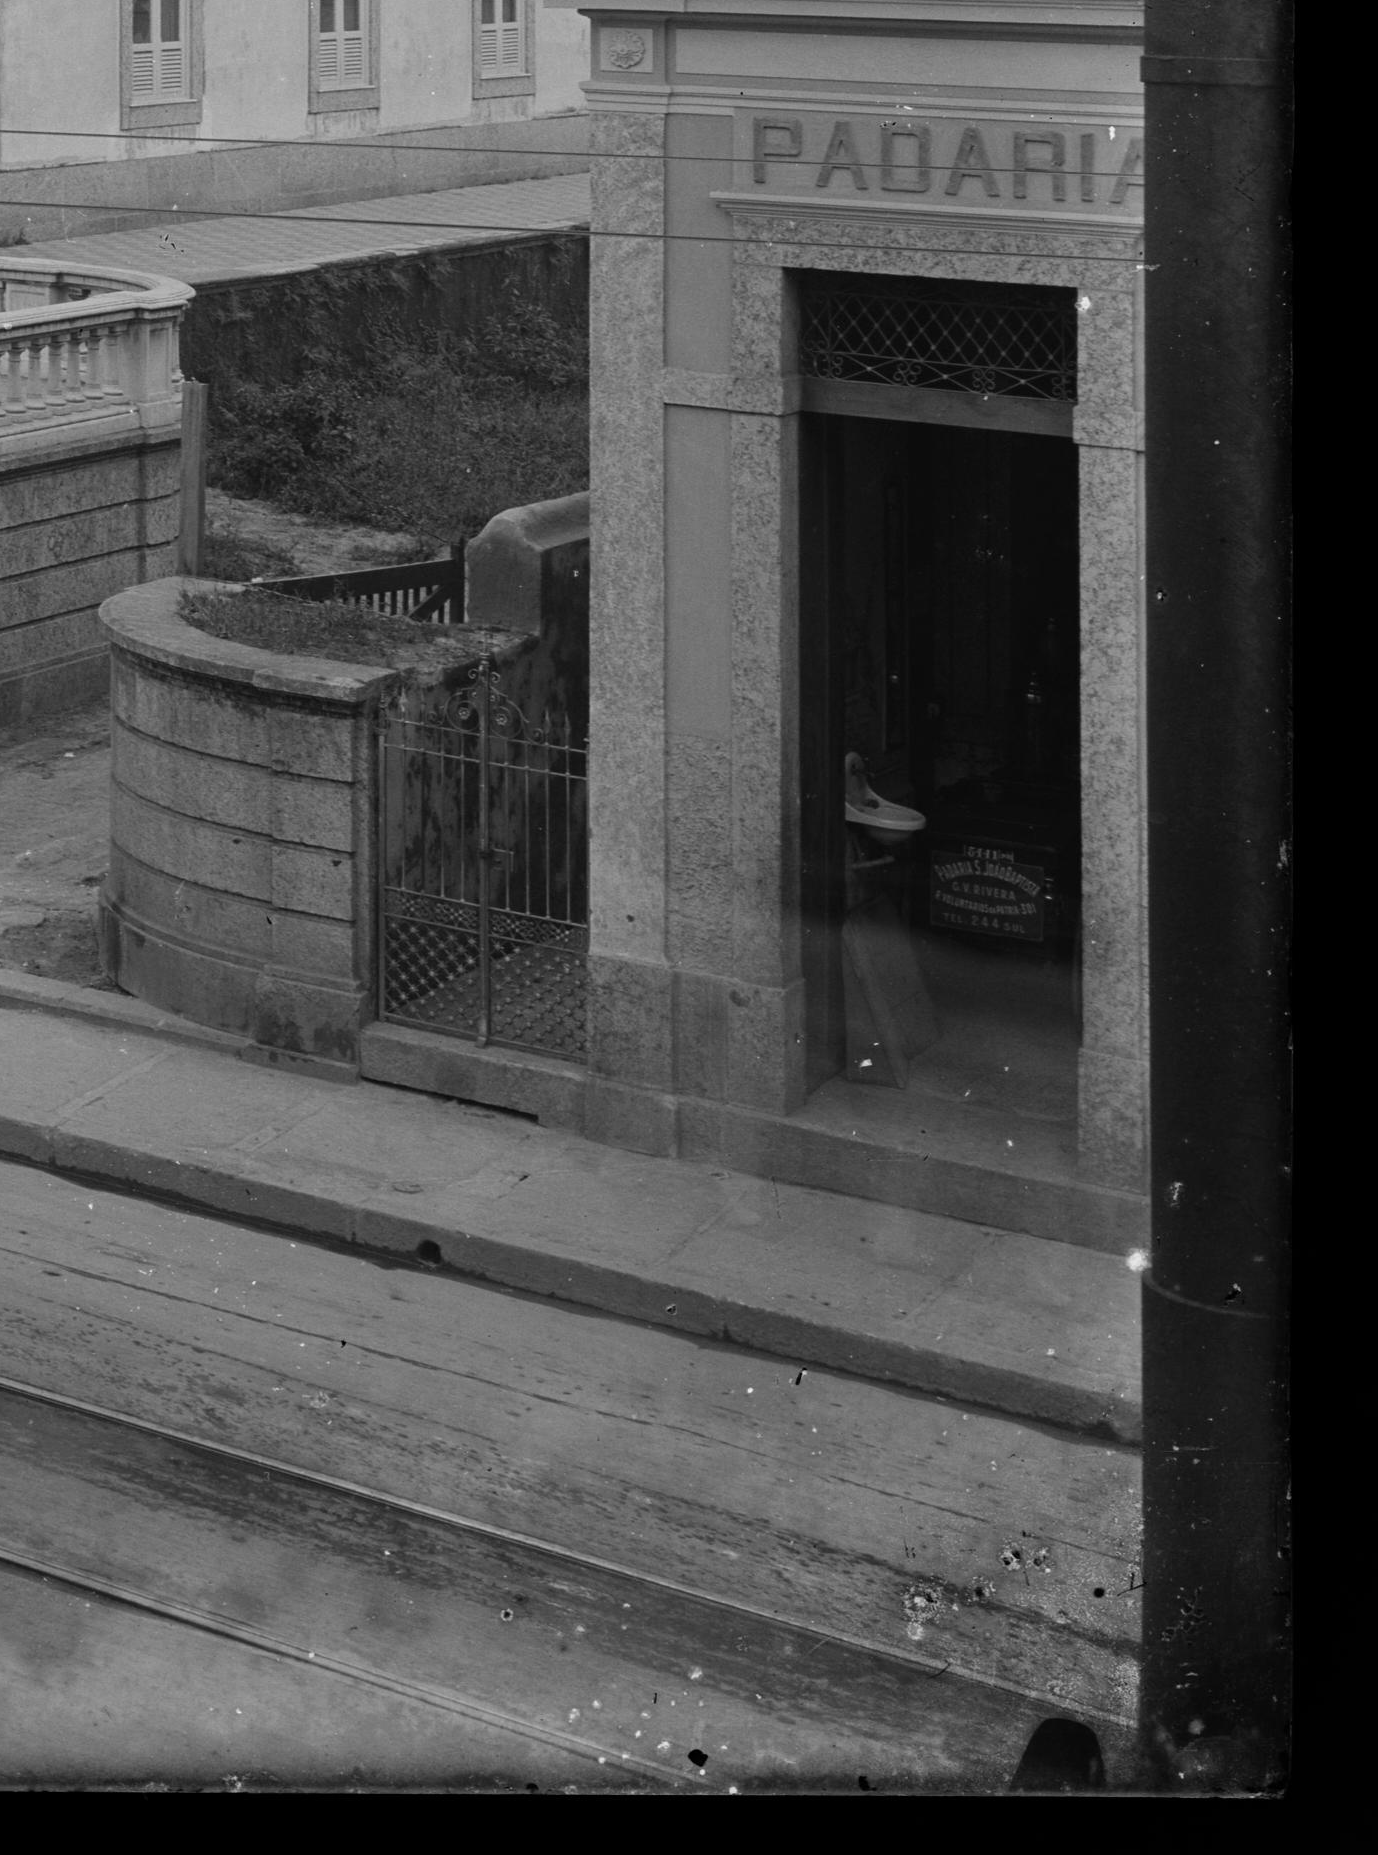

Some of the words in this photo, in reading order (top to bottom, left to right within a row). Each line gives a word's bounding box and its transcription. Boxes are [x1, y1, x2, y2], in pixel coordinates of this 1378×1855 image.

[752, 116, 1145, 204] PADARIA
[973, 884, 1017, 901] RIVERA
[1003, 922, 1026, 934] SUL
